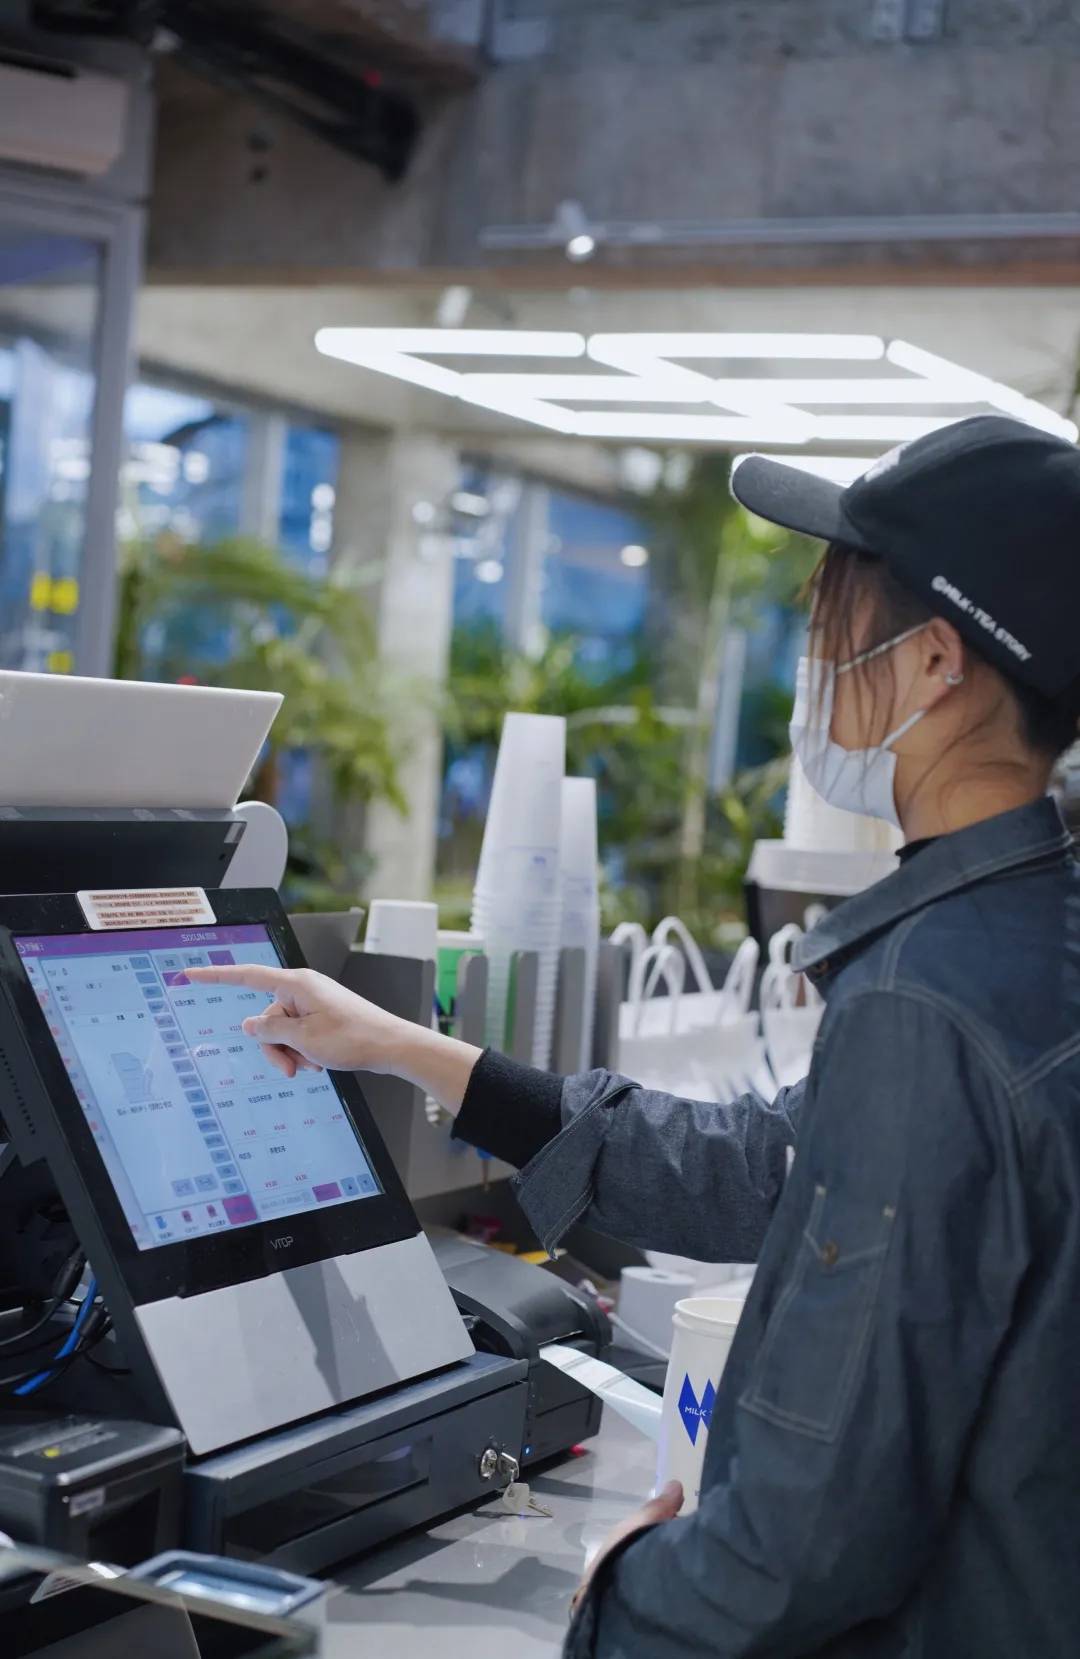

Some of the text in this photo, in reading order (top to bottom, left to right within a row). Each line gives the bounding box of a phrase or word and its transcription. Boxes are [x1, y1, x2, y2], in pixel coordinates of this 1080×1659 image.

[942, 584, 1032, 660] MILK TEA STORY
[684, 1406, 707, 1417] MILK
